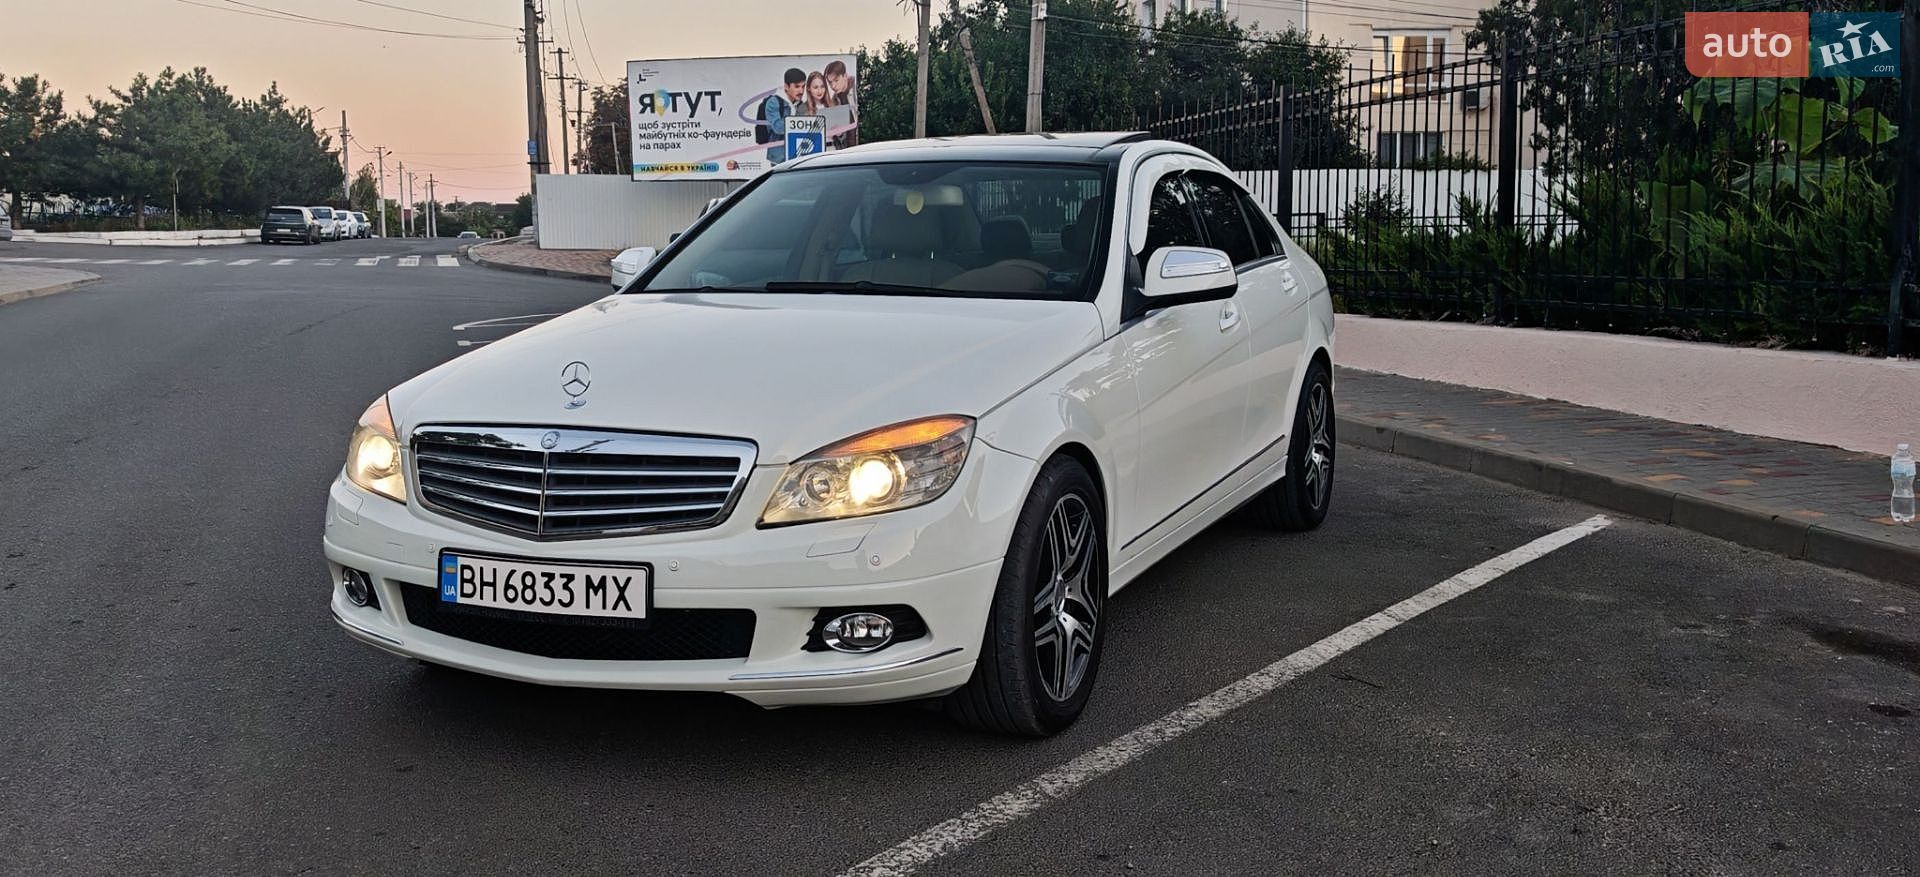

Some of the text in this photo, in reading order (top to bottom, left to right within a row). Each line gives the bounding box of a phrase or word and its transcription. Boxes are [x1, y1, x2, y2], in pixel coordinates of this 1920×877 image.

[638, 119, 701, 131] щоб зустріти
[638, 127, 752, 140] майбутніх ко-фаундерів
[639, 141, 682, 152] на парах
[444, 584, 456, 597] UA
[503, 569, 576, 608] 6833
[585, 574, 633, 612] MX
